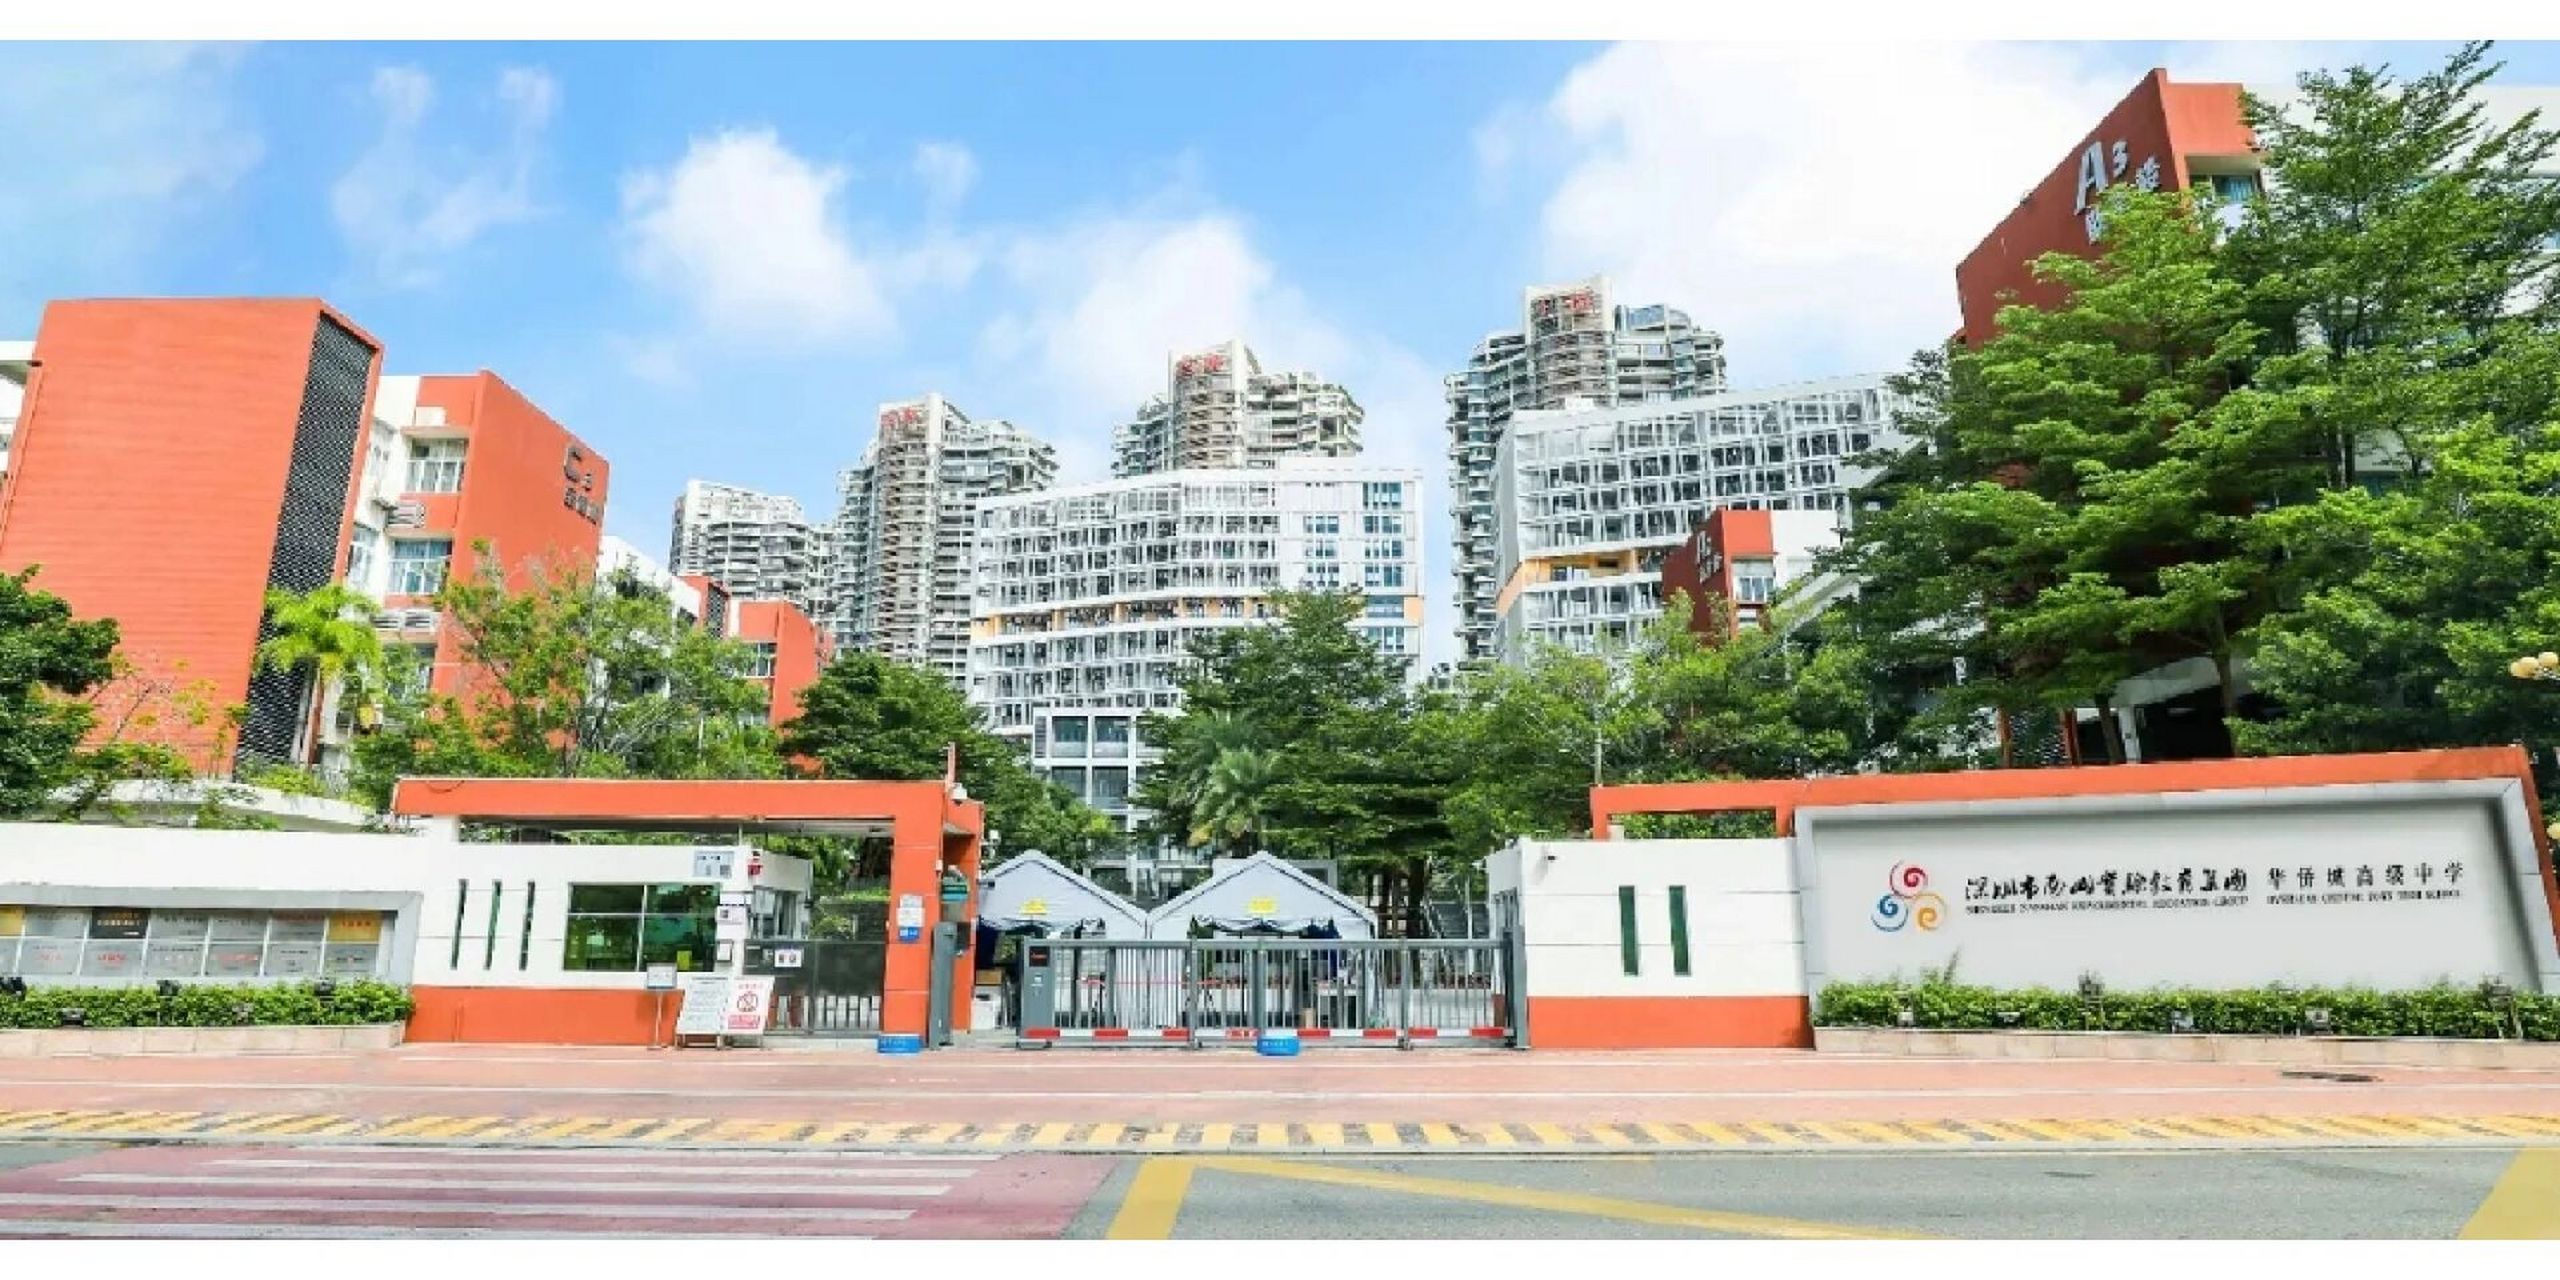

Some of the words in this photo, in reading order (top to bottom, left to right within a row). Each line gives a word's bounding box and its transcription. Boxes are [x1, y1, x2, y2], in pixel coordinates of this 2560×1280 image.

[2267, 860, 2464, 891] 华侨城高级中学
